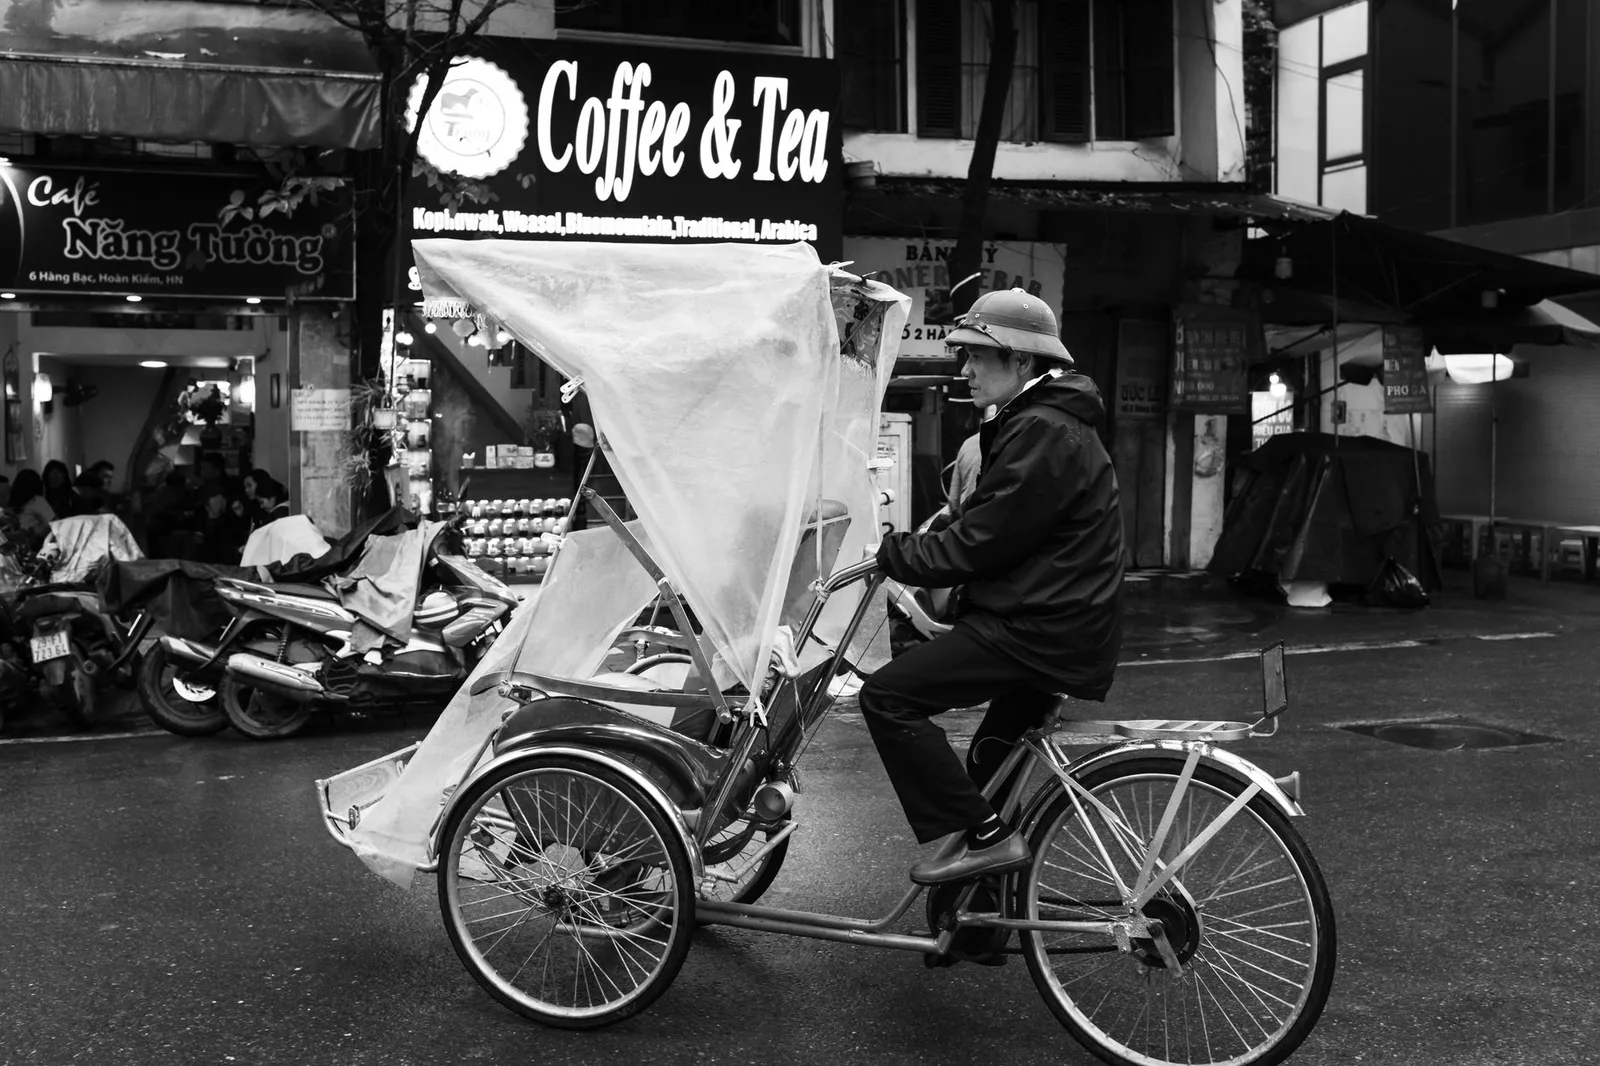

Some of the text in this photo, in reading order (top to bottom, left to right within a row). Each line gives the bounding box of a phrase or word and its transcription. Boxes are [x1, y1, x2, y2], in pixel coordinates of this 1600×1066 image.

[538, 60, 830, 202] Coffee & Tea
[27, 175, 100, 217] Café
[62, 217, 324, 275] Năng Tường
[761, 219, 818, 241] Arabica
[28, 271, 37, 282] 6
[39, 271, 70, 284] Hàng
[72, 272, 97, 285] Bạc,
[98, 273, 129, 284] Hoàn
[166, 275, 184, 285] HN
[914, 328, 923, 340] 2
